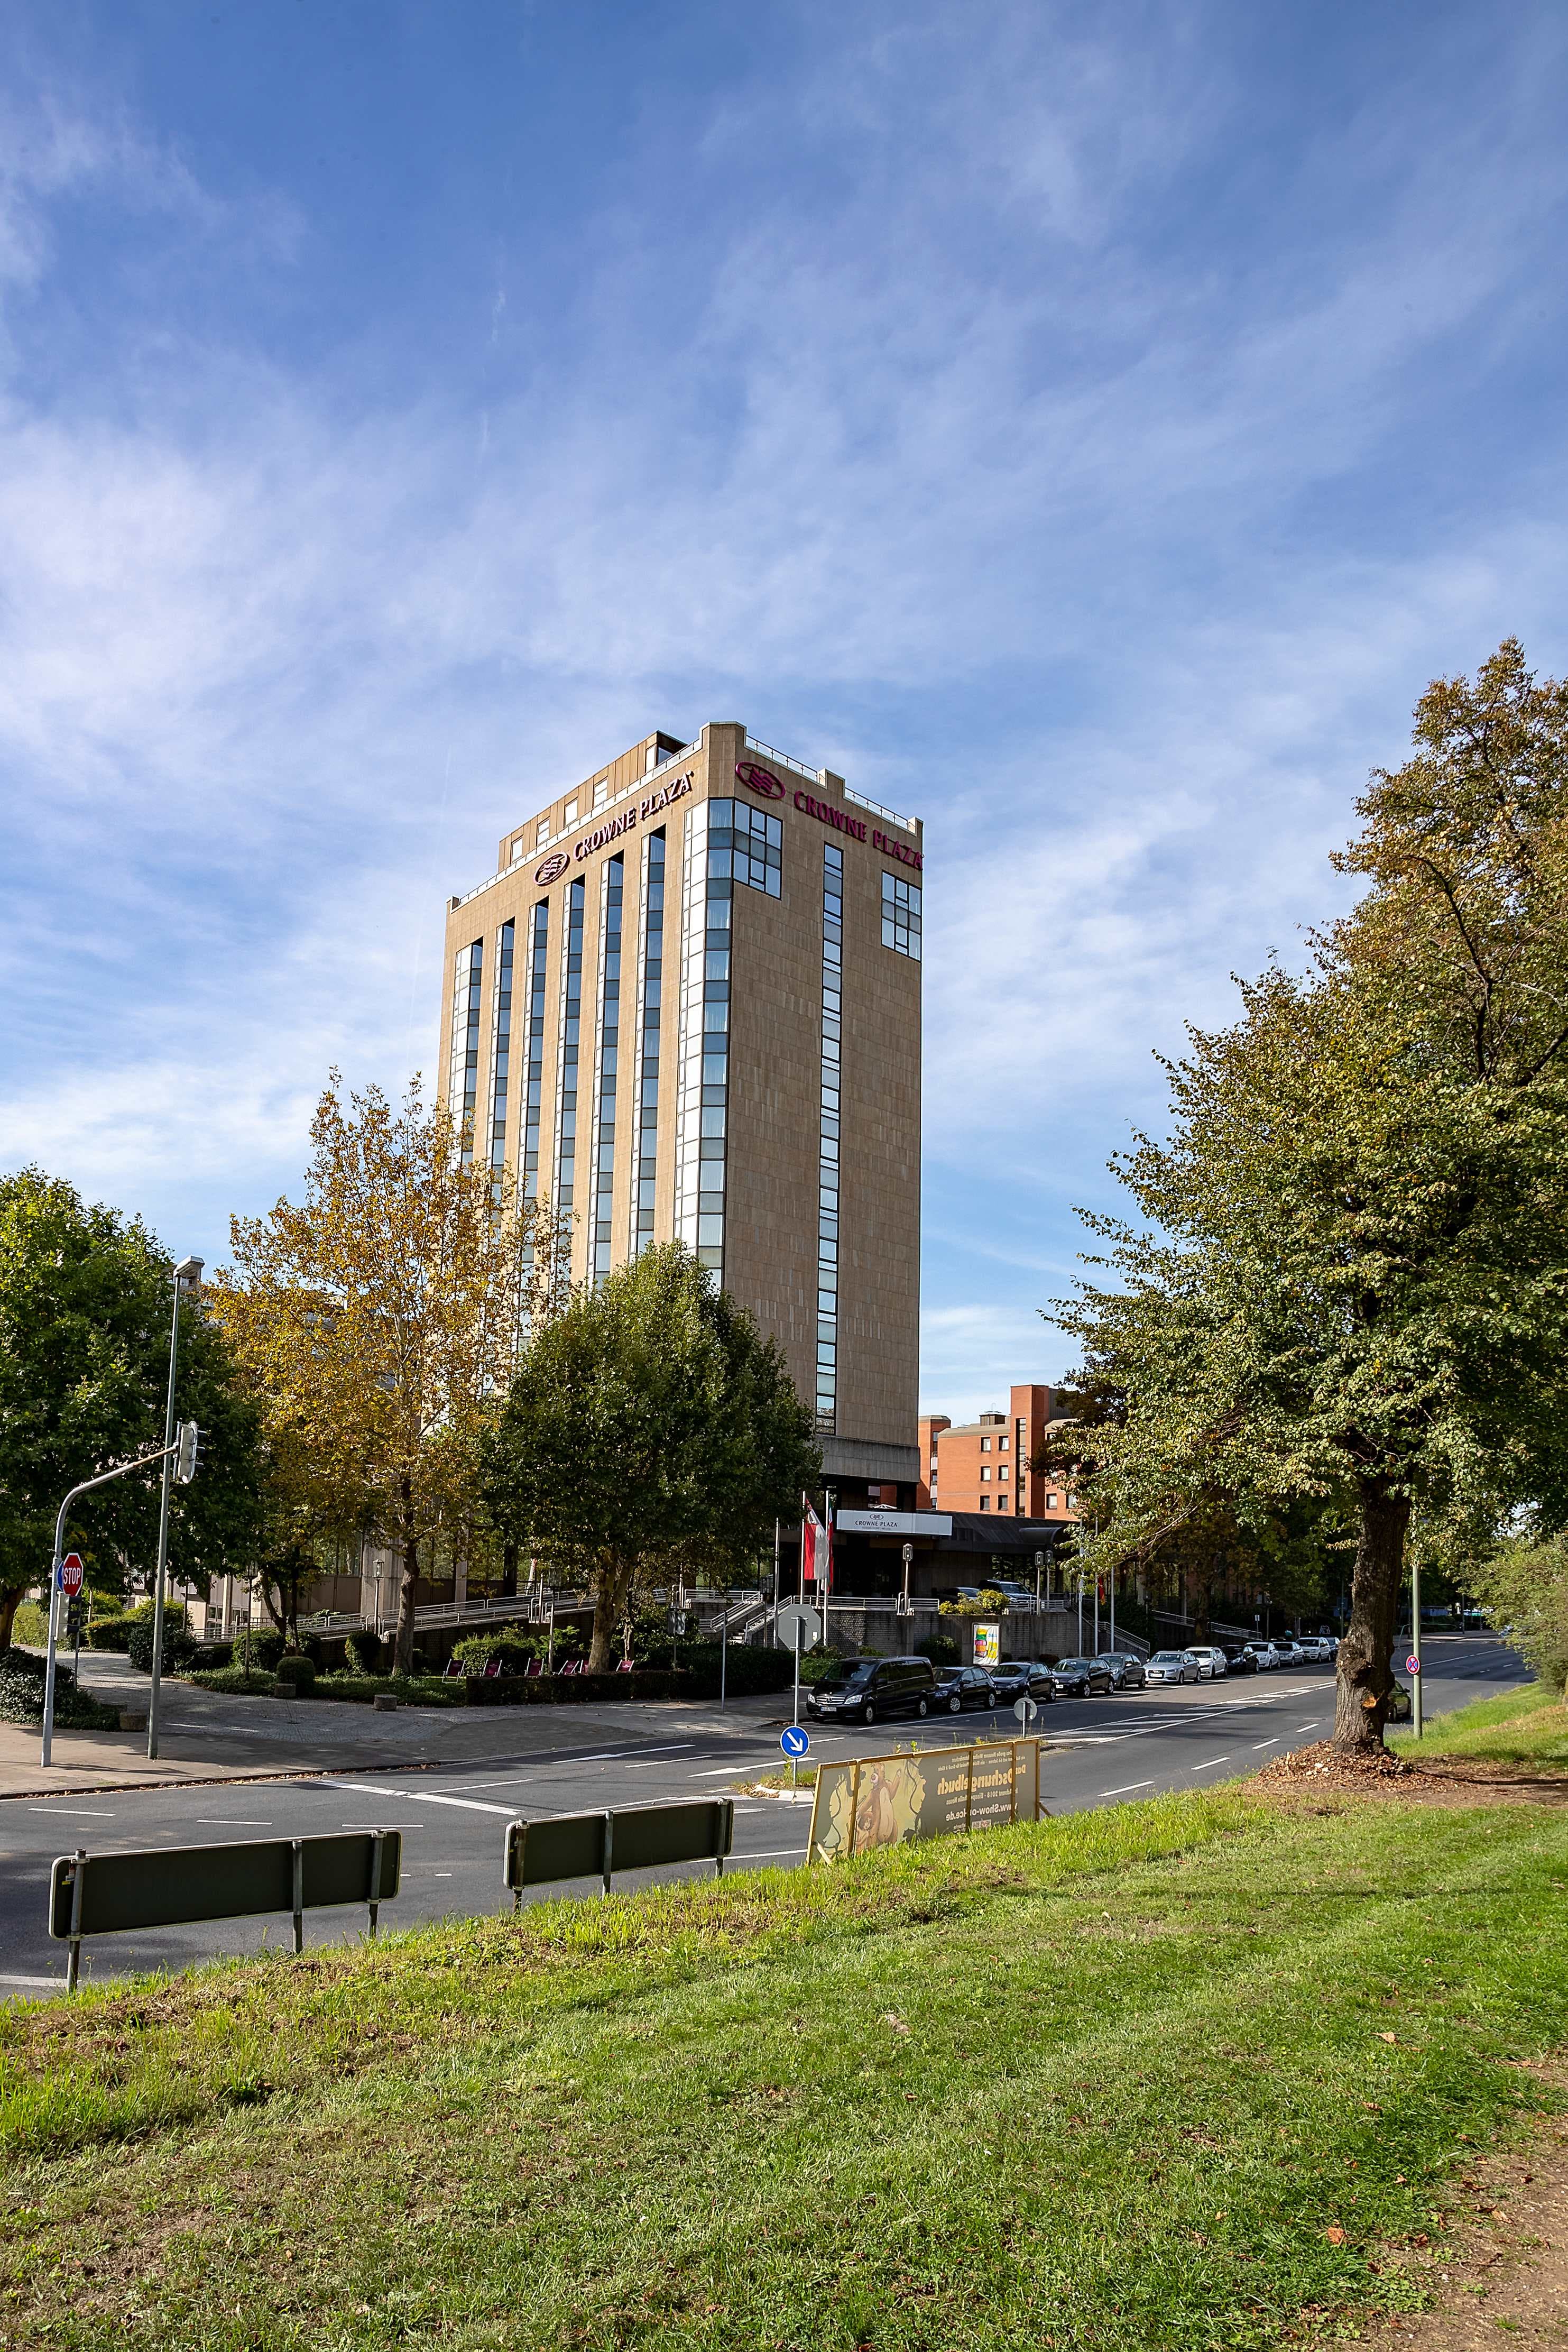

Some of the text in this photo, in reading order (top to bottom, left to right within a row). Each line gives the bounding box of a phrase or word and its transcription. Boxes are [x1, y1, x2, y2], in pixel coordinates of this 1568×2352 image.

[573, 773, 692, 861] CROWNE PLAZA
[794, 790, 923, 870] CROWNE PLAZA
[63, 1567, 81, 1585] STOP
